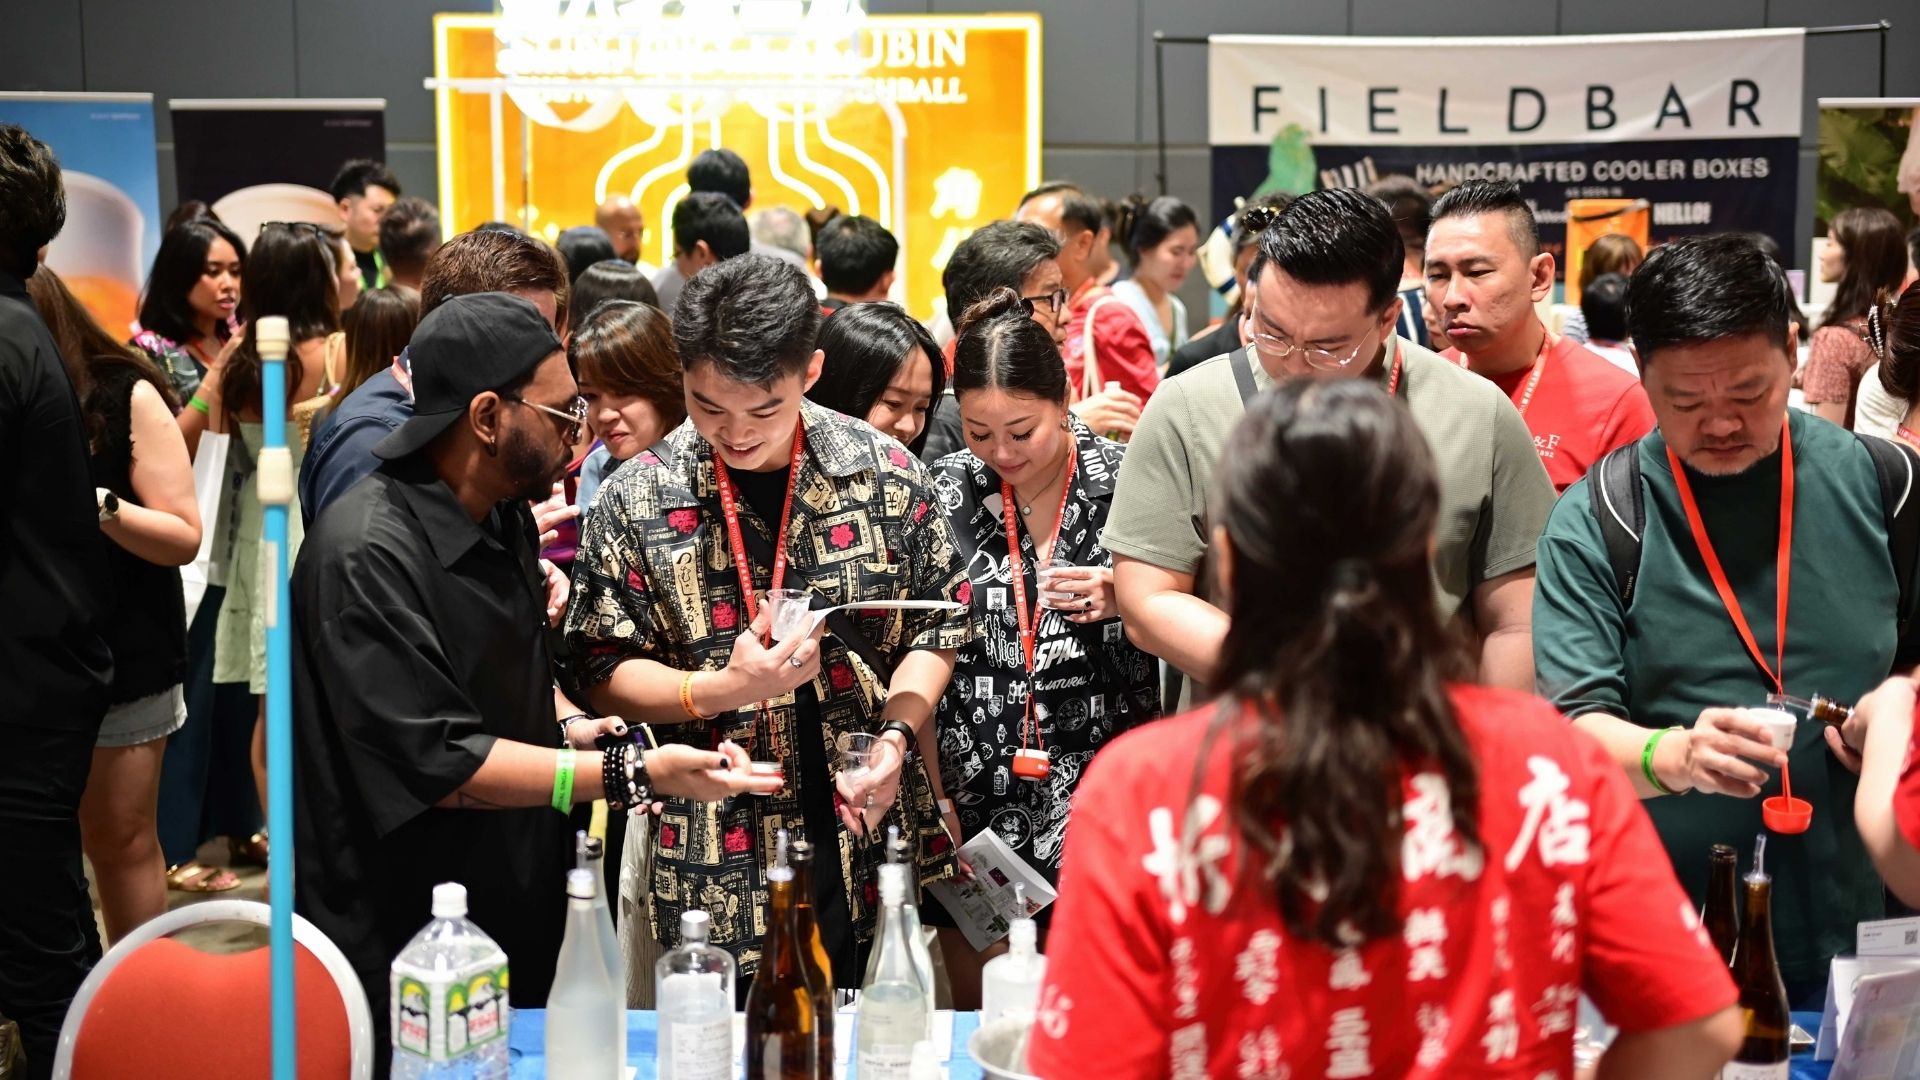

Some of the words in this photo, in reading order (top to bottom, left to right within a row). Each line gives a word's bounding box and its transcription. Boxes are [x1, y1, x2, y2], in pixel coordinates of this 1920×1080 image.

[1252, 78, 1762, 134] FIELDBAR
[1416, 161, 1587, 184] HANDCRAFTED
[1593, 159, 1686, 182] COOLER
[1694, 157, 1770, 179] BOXES
[1653, 202, 1712, 225] HELLO!
[1080, 449, 1110, 484] JOIN
